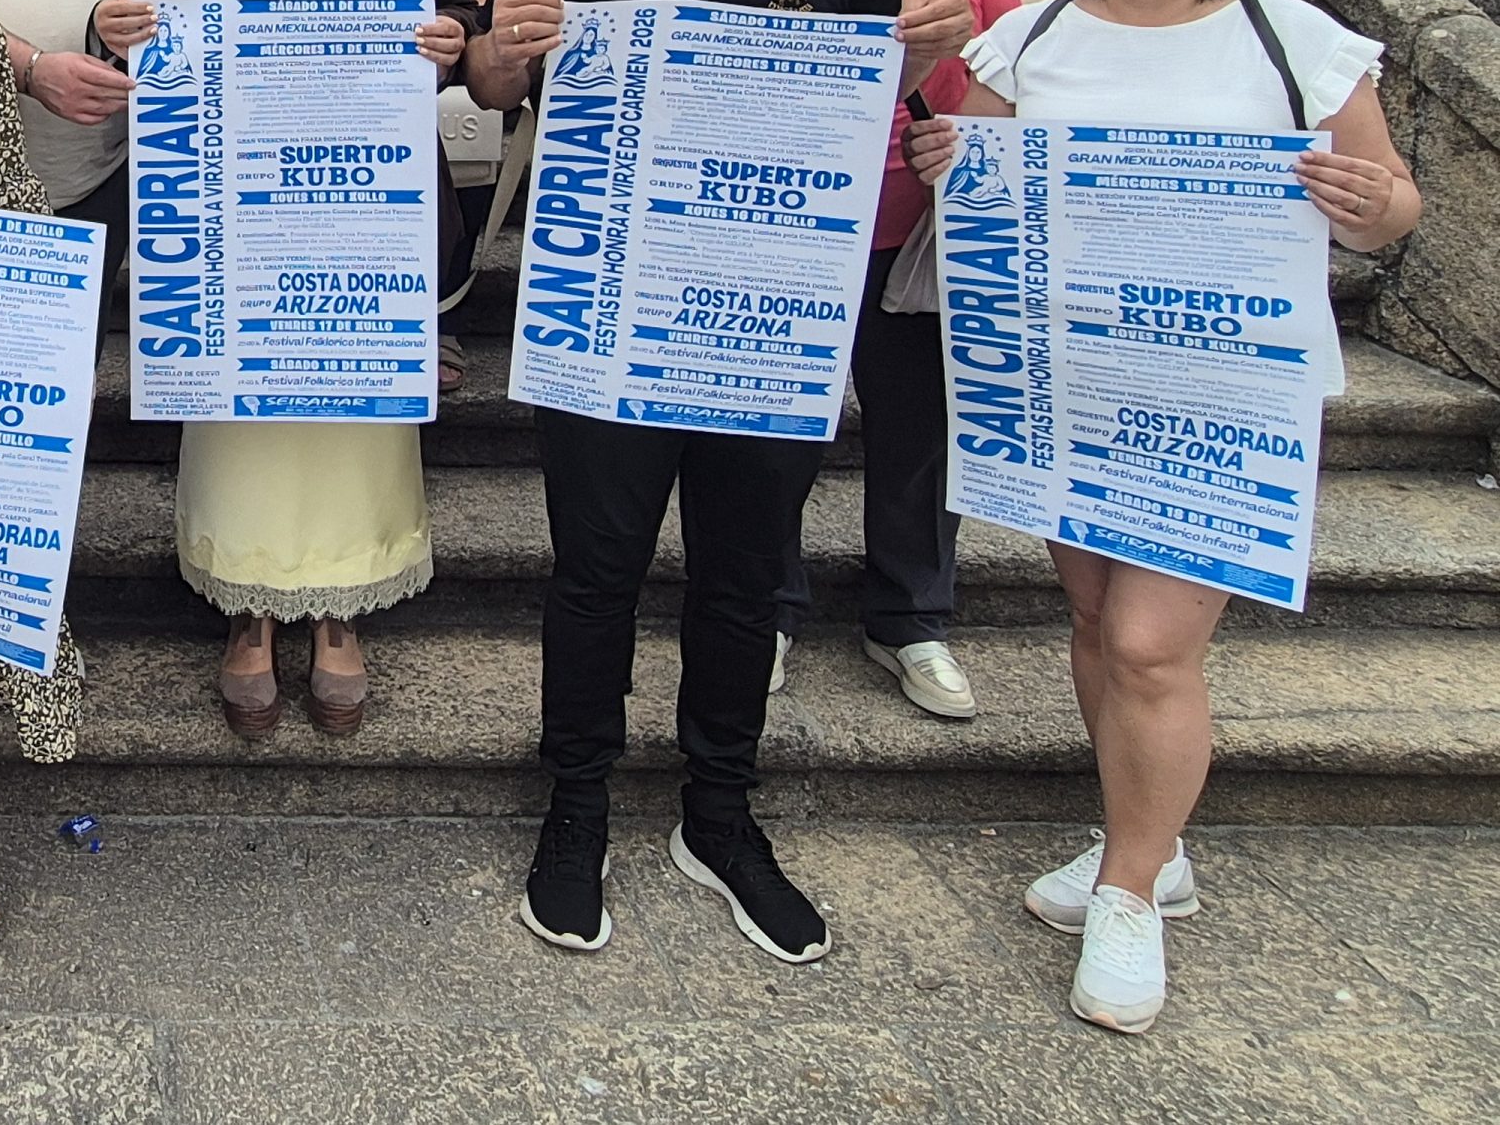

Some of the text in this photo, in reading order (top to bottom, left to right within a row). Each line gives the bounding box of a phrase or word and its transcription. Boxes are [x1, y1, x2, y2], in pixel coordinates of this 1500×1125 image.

[710, 11, 857, 32] SÁBADO 11 DE XULLO
[671, 31, 884, 57] GRAN MEXILLONADA POPULAR
[280, 145, 411, 163] SUPERTOP
[1068, 153, 1296, 174] GRAN MEXILLONADA POPULA
[202, 3, 224, 356] FESTAS EN HONRA A VIRXE DO CARMEN 2026
[280, 167, 374, 186] KUBO
[593, 8, 656, 357] FESTAS EN HONRA A VIRXE DO CARMEN 2026
[700, 158, 851, 190] SUPERTOP
[649, 179, 806, 209] GRUPO KUBO
[137, 96, 201, 357] SAN CIPRIAN
[524, 95, 617, 352] SAN CIPRIAN
[278, 273, 426, 292] COSTA DORADA
[1023, 129, 1054, 469] FESTAS EN HONRA A VIRXE DO CARMEN 2026
[1119, 283, 1291, 317] SUPERTOP
[272, 295, 379, 315] ARIZONA
[682, 286, 845, 321] COSTA DORADA
[1065, 304, 1241, 336] GRUPO KUBO
[672, 308, 791, 337] ARIZONA
[945, 214, 1027, 463] SAN CIPRIAN
[1072, 424, 1241, 470] GRUPO ARIZONA
[1117, 407, 1196, 437] COSTA
[1205, 420, 1303, 461] DORADA
[1108, 450, 1257, 493] VENRES 17 DE XULLO
[1098, 463, 1147, 483] Festival
[1209, 491, 1298, 521] Internacional
[1093, 504, 1140, 524] Festival
[1202, 534, 1250, 553] Infantil
[1105, 490, 1258, 538] SÁBADO 18 DE XULLO
[1095, 528, 1214, 567] SEIRAMAR
